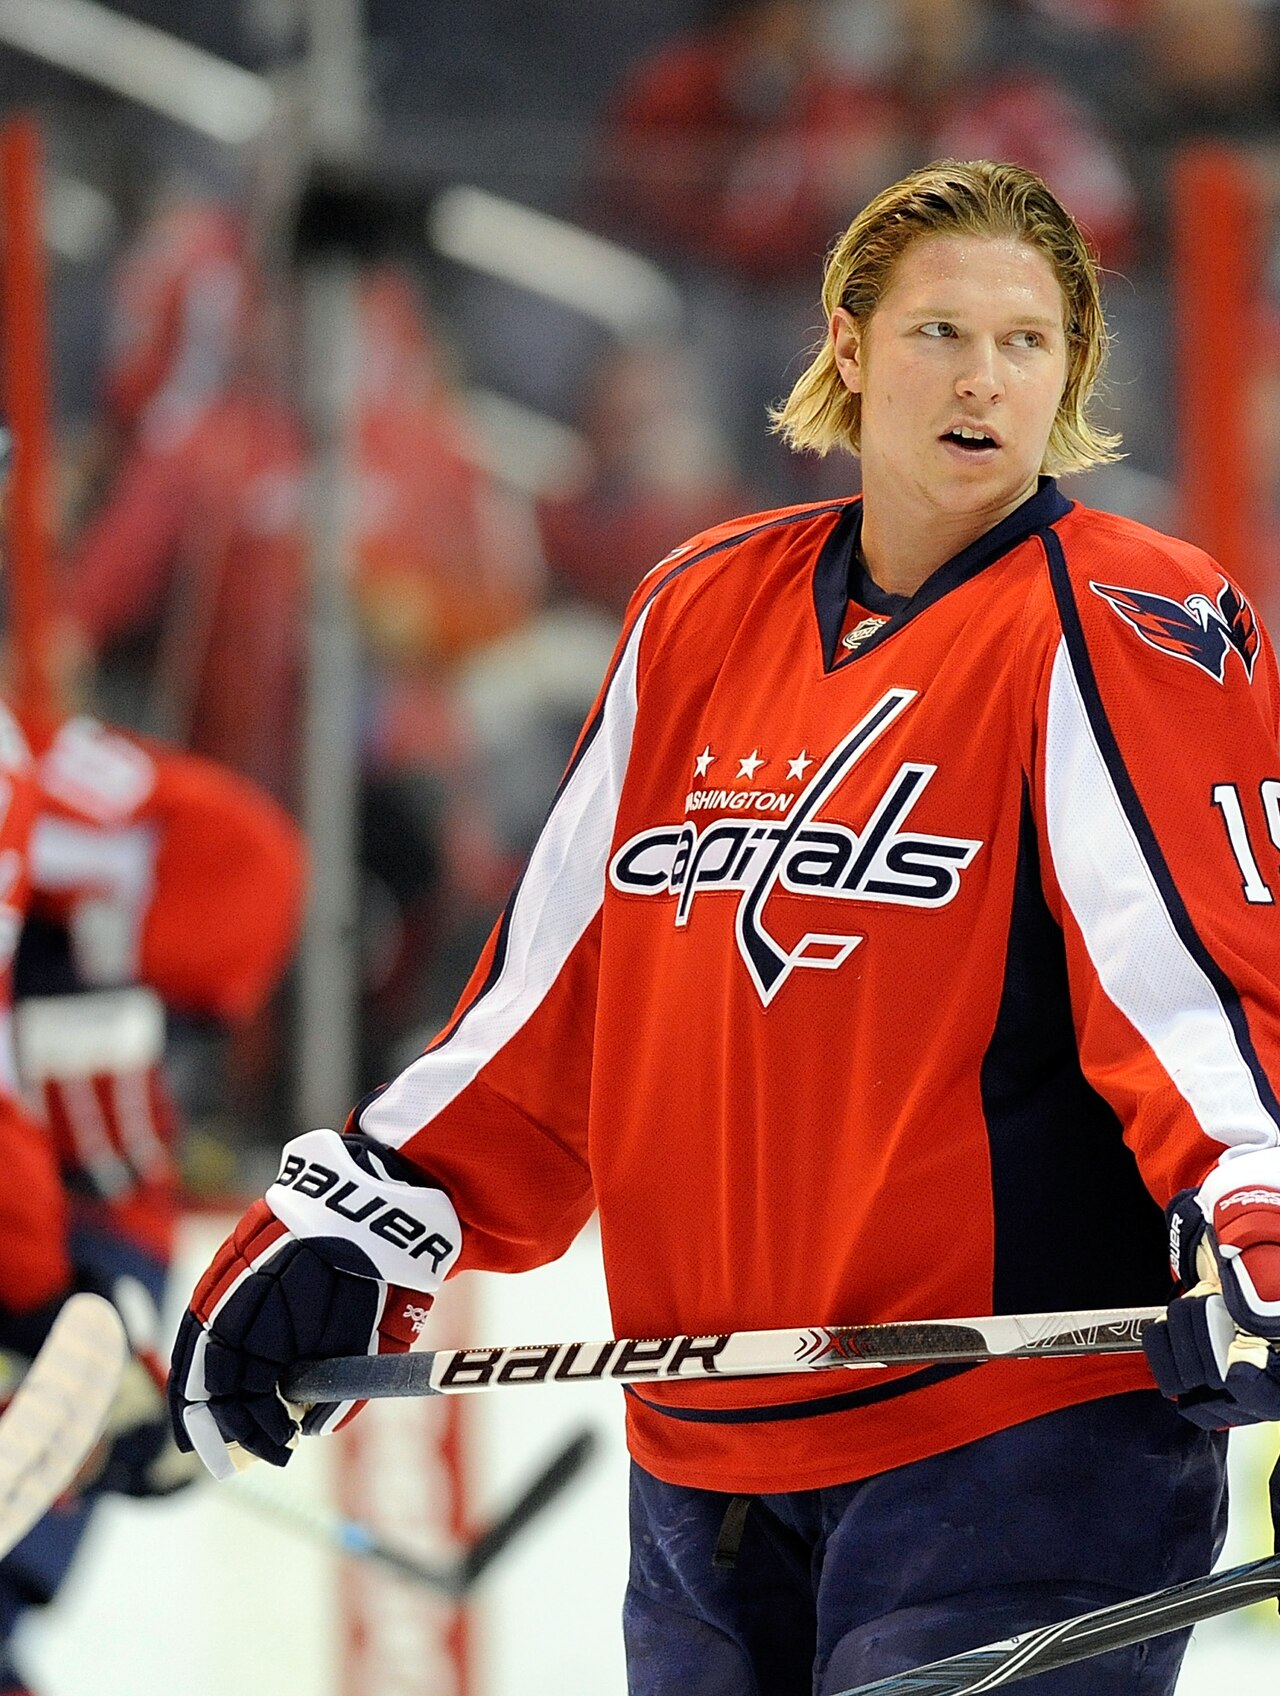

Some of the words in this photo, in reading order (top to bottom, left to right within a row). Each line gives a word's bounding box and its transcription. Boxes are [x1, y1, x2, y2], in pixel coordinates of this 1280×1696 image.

[609, 688, 983, 1008] capitals
[276, 1153, 454, 1274] BAUER
[439, 1334, 731, 1389] BAUER
